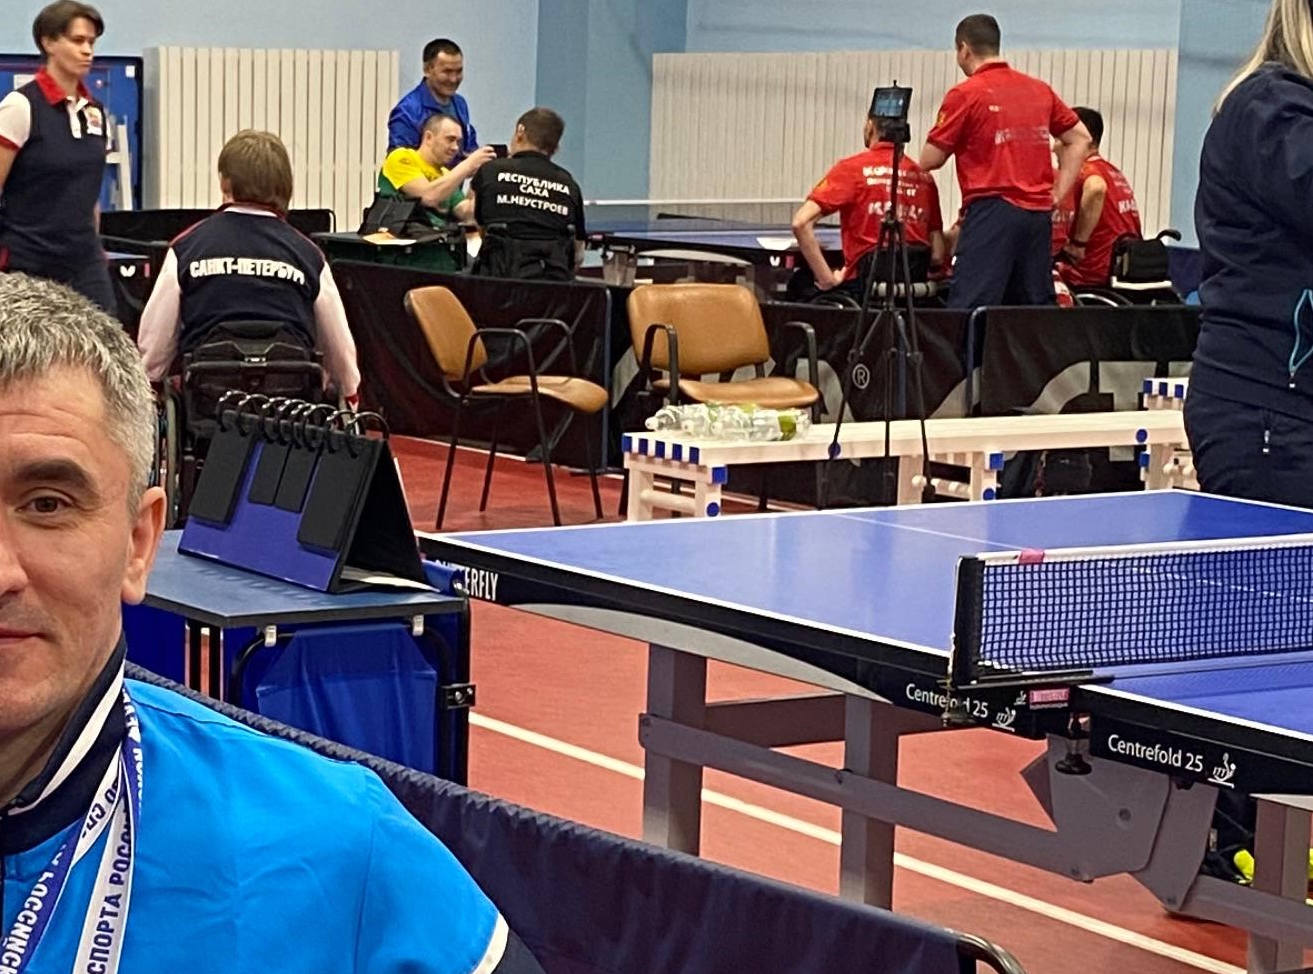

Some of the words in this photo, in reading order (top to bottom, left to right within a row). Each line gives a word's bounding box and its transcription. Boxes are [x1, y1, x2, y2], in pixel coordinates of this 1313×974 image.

[497, 172, 570, 195] РЕСПУБЛИКА
[519, 183, 549, 198] САХА
[497, 194, 568, 216] М.НЕУСТРОЕВ
[189, 257, 305, 285] САНКТ-ПЕТЕРБУРГ
[972, 699, 989, 719] 25
[1107, 734, 1182, 768] Centrefold
[1185, 752, 1204, 773] 25
